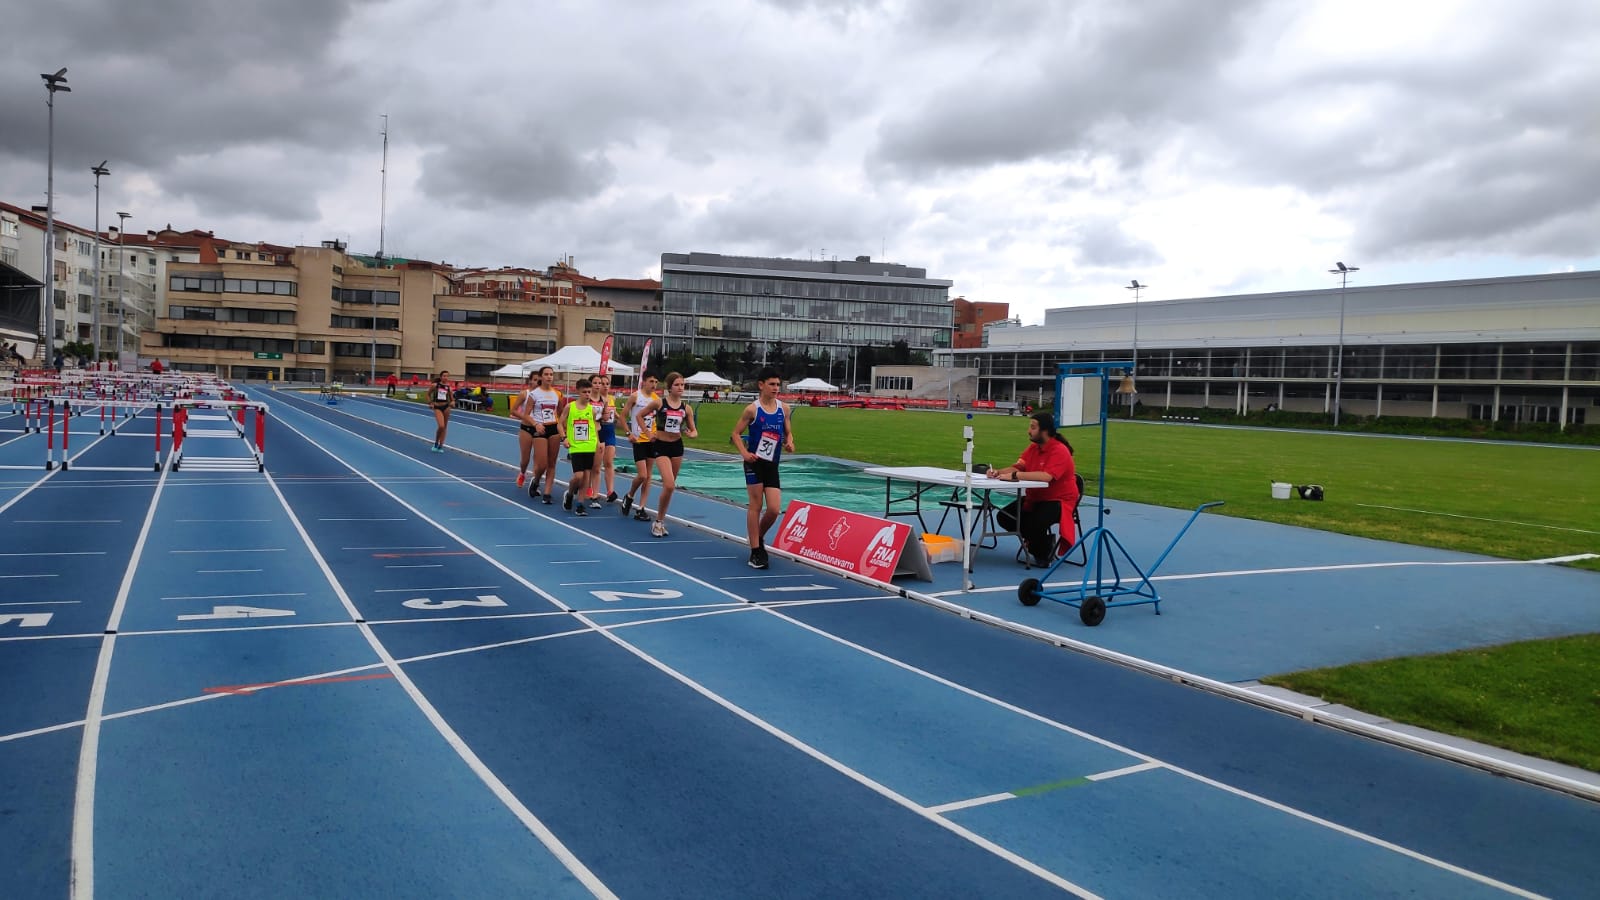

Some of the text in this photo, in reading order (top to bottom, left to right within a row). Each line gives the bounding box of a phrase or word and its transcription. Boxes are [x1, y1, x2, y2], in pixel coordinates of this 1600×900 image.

[575, 426, 588, 437] 34
[759, 440, 773, 455] 30
[791, 525, 808, 539] FNA
[799, 546, 855, 570] #atletismonavarro
[873, 546, 896, 563] FNA
[589, 588, 684, 602] 2
[760, 583, 840, 592] 1
[402, 594, 508, 610] 3
[177, 605, 296, 621] 4
